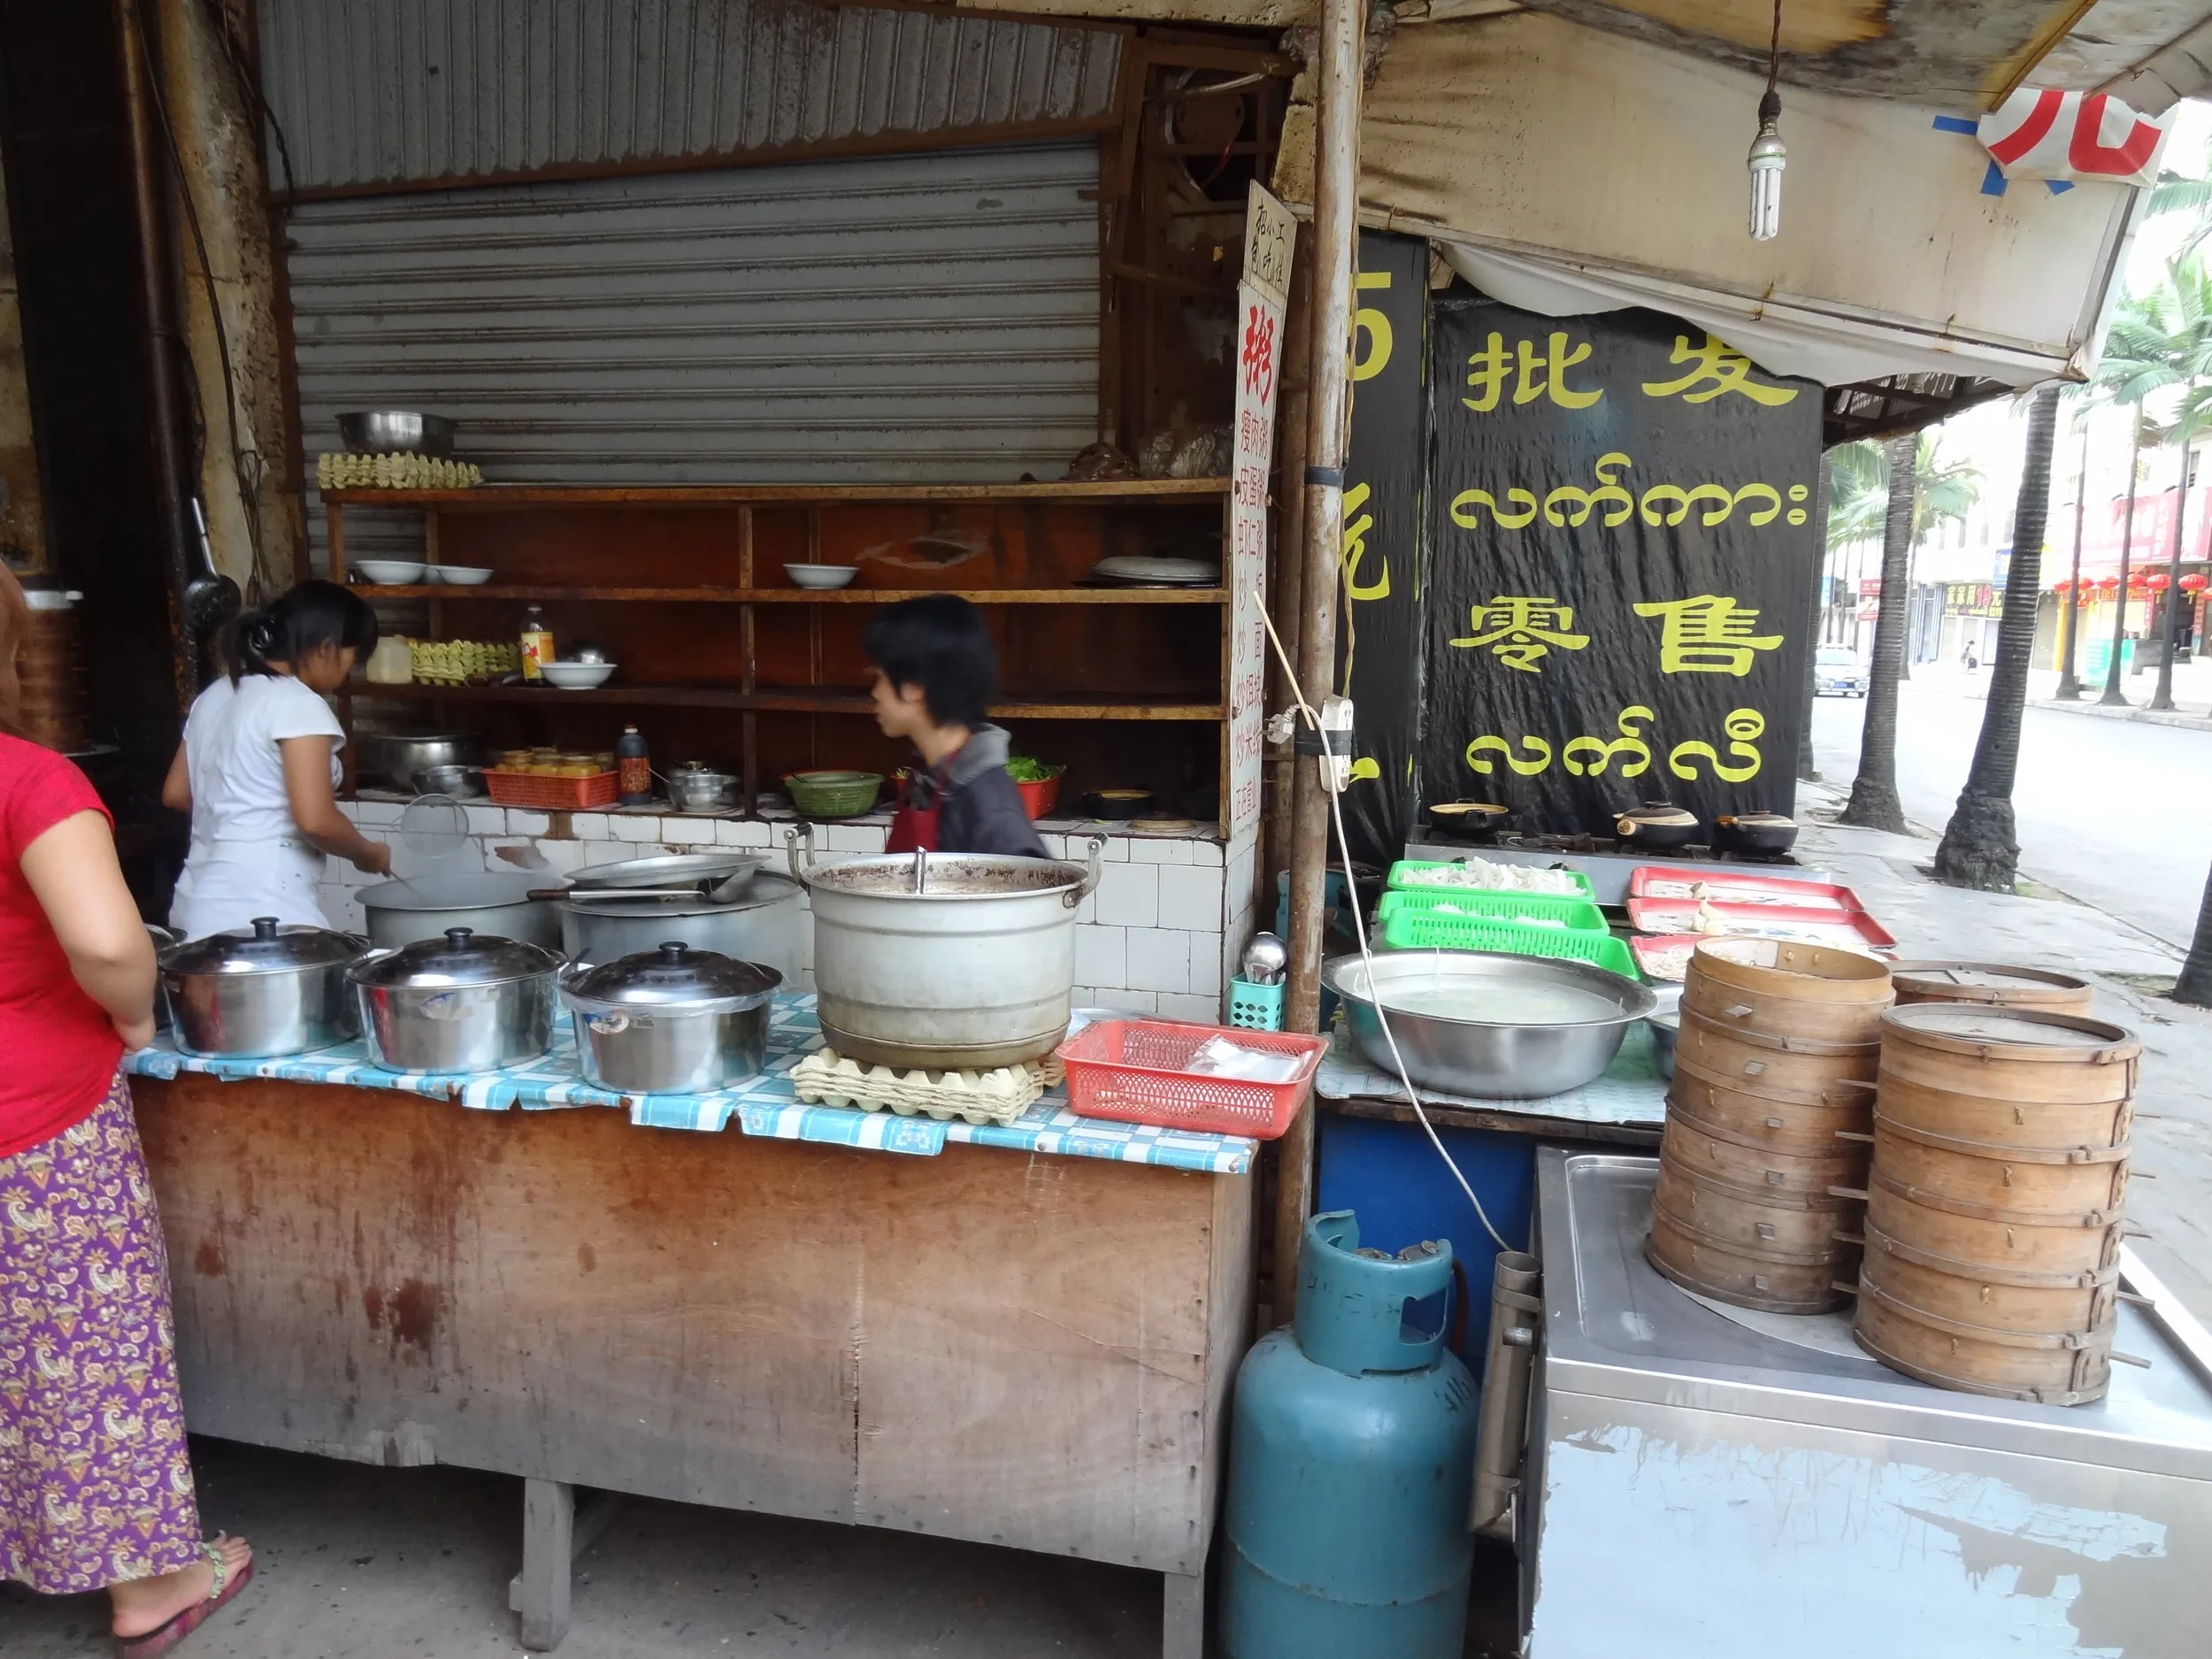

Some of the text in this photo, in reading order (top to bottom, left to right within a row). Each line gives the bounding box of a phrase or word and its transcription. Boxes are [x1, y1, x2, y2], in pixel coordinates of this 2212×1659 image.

[1242, 304, 1274, 408] 粥
[1240, 408, 1268, 460] 瘦肉粥
[1238, 462, 1264, 509] 皮蛋粥
[1238, 516, 1263, 561] 虾仁粥
[1237, 621, 1262, 664] 炒面
[1449, 594, 1785, 678] 零售
[1235, 668, 1262, 718] 炒饵块
[1235, 717, 1261, 768] 炒米线
[1236, 776, 1256, 822] 正在营业
